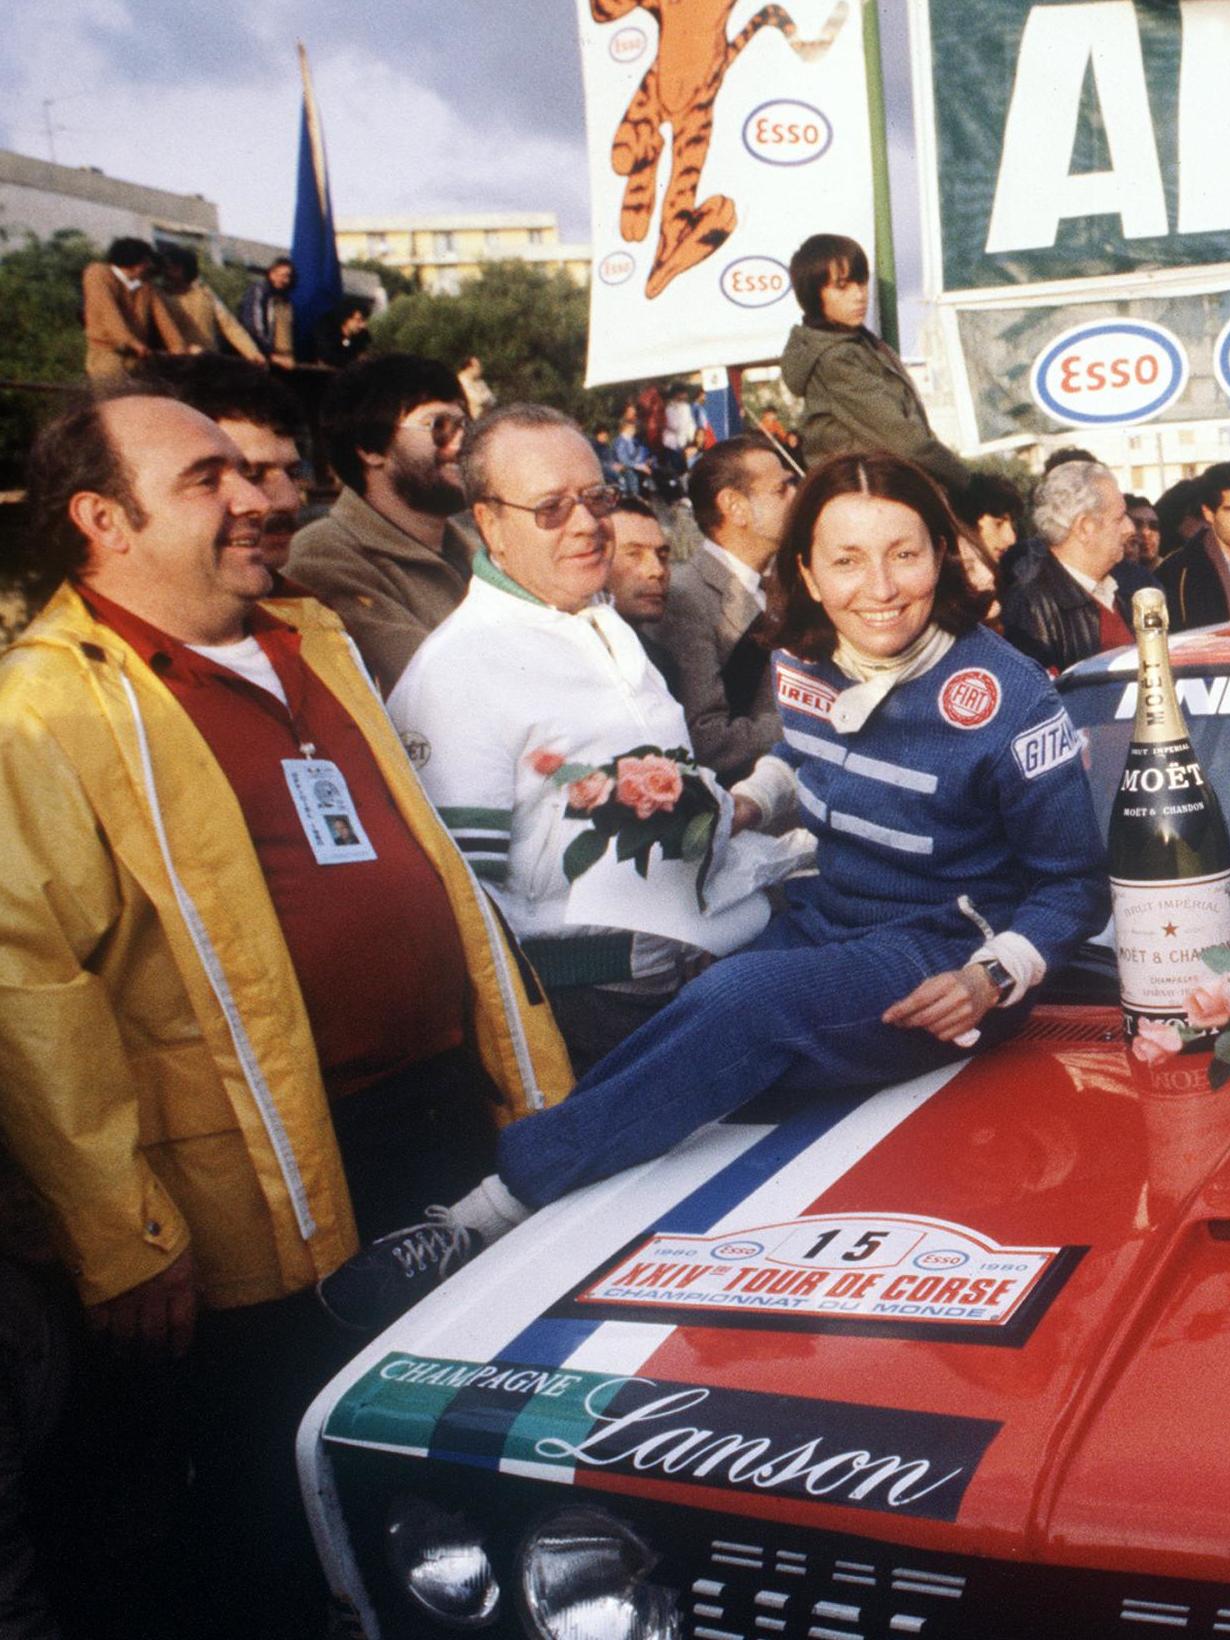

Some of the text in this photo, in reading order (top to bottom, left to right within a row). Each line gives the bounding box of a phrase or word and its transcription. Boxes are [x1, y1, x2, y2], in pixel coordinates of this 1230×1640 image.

[952, 684, 987, 711] FIAT
[1120, 762, 1204, 793] MOËT
[1162, 801, 1205, 816] CHANDON
[1152, 951, 1162, 964] &
[803, 1227, 890, 1263] 15
[979, 1262, 1029, 1273] 1980
[723, 1266, 832, 1297] TOUR
[827, 1272, 879, 1300] DE
[884, 1275, 1015, 1306] CORSE
[602, 1287, 993, 1318] CHAMPIONNAT DU MONDE
[379, 1359, 583, 1397] CHAMPAGNE
[535, 1376, 963, 1509] Lanson
